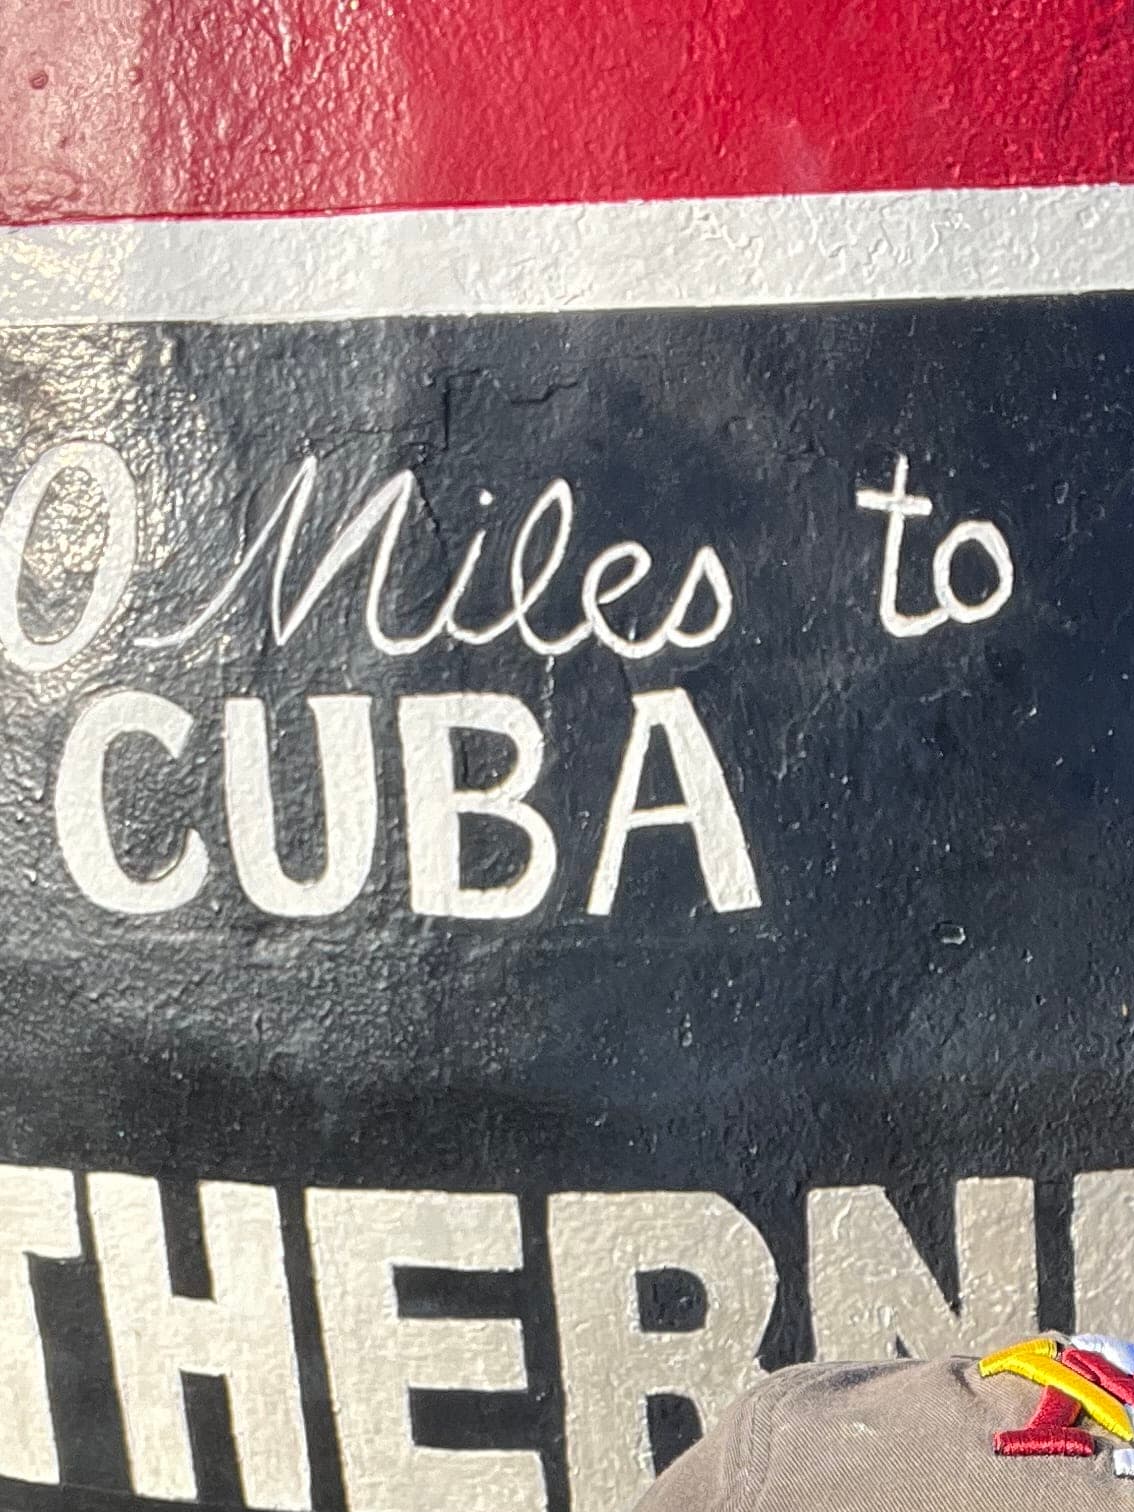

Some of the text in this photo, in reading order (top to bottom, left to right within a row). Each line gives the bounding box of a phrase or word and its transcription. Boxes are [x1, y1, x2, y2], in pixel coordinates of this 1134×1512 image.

[134, 456, 732, 658] Miles
[857, 456, 1013, 638] to
[55, 689, 763, 920] CUBA
